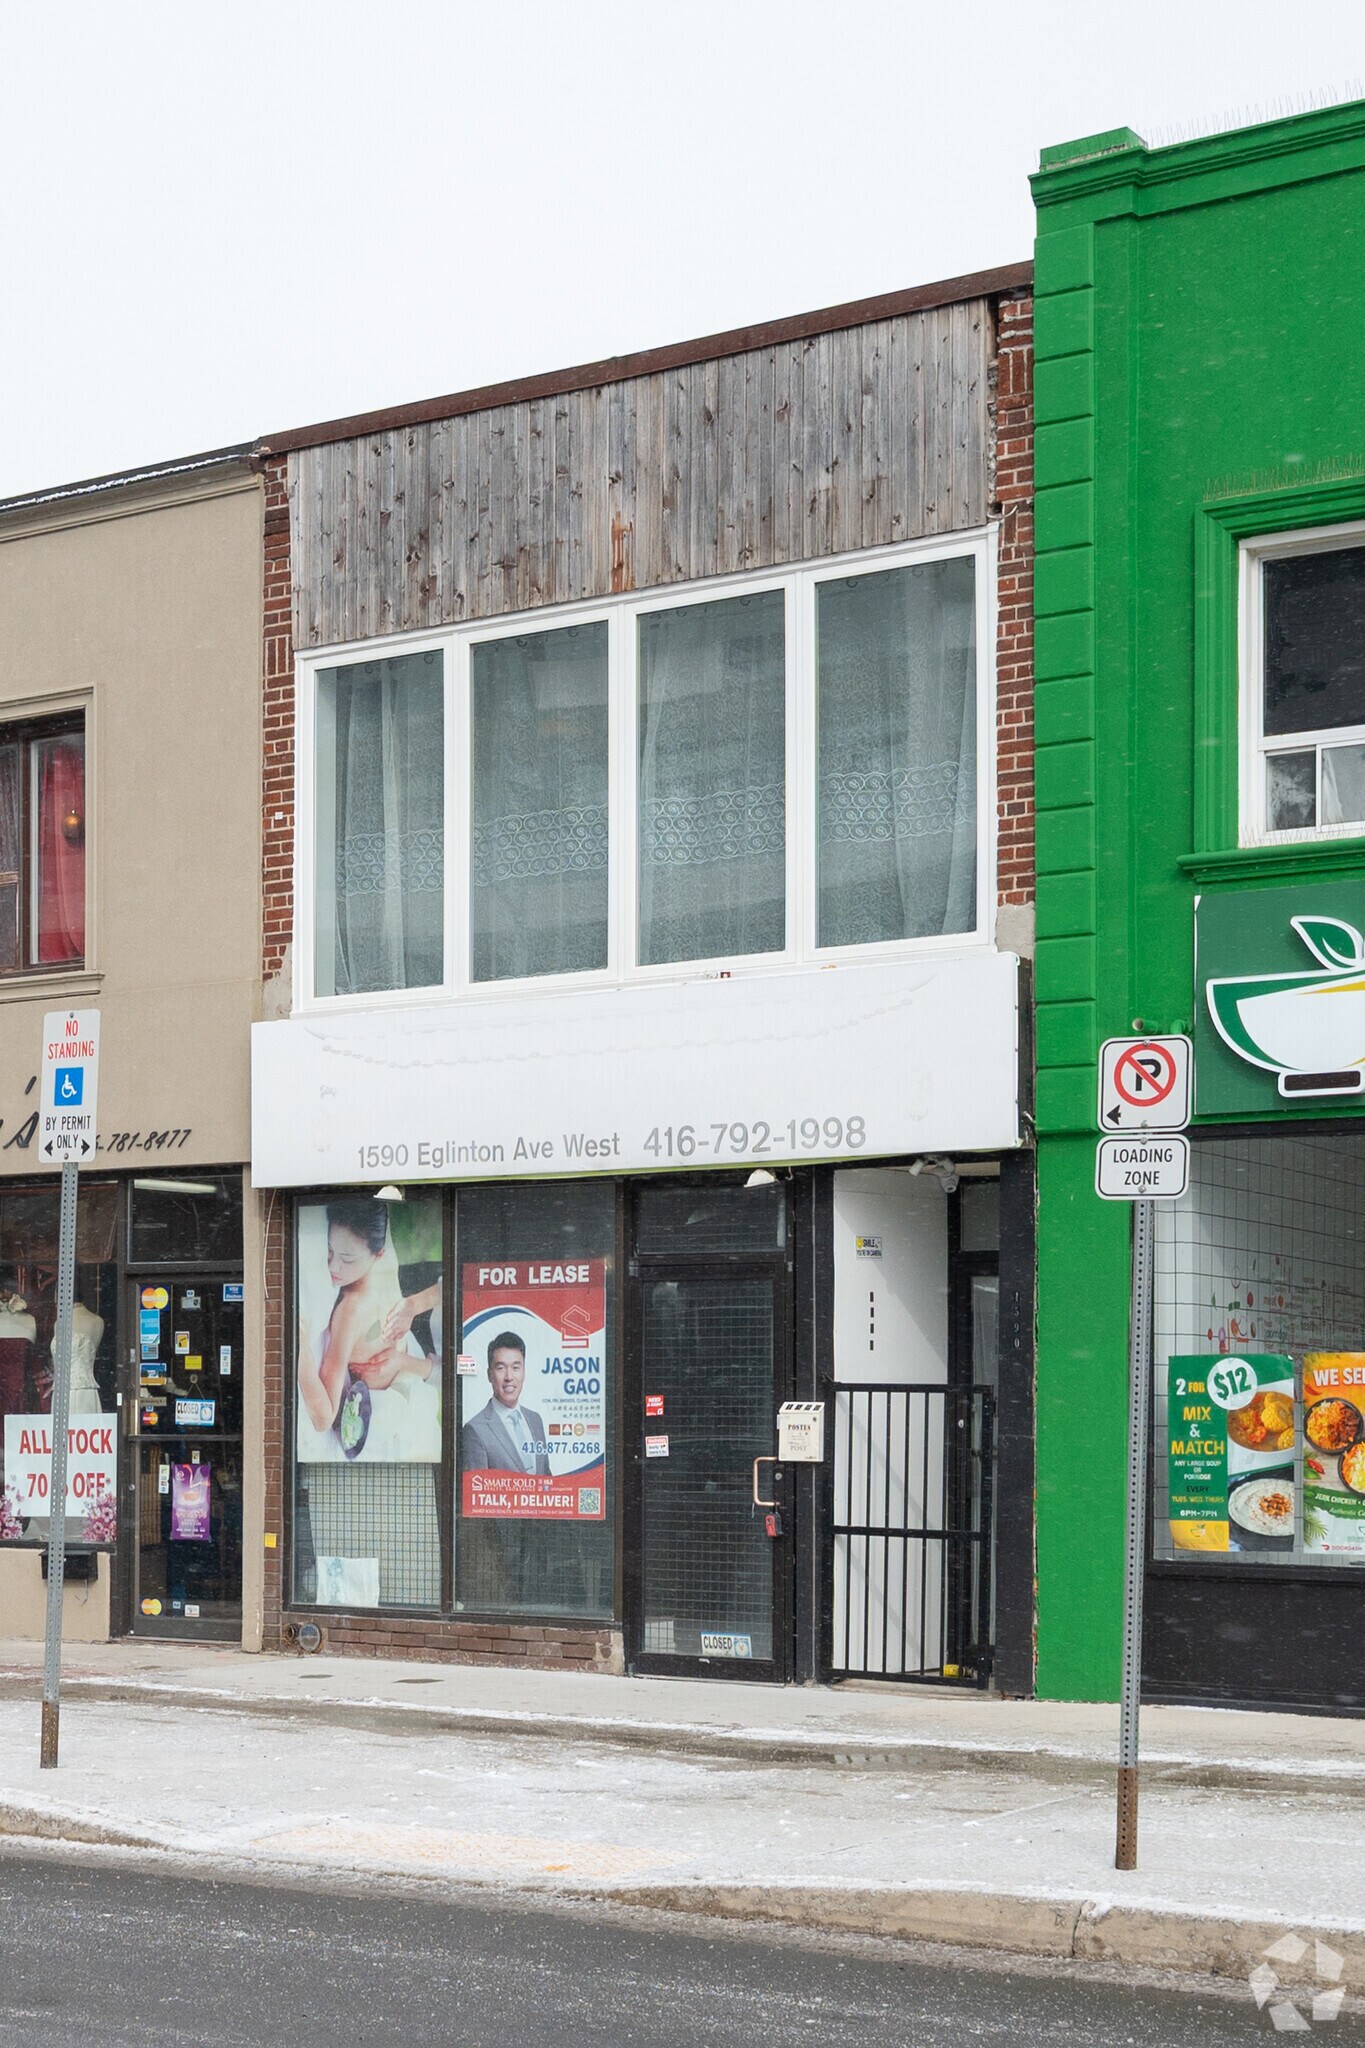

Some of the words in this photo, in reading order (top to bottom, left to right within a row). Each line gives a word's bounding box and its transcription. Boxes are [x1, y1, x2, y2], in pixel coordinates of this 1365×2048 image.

[65, 1020, 79, 1037] NO
[48, 1040, 95, 1060] STANDING
[46, 1116, 57, 1132] BY
[61, 1114, 91, 1131] PERMIT
[56, 1134, 79, 1149] ONLY
[643, 1115, 866, 1157] 416-792-1998
[358, 1143, 409, 1169] 1590
[417, 1140, 504, 1169] Eglinton
[512, 1136, 554, 1161] Ave
[562, 1132, 621, 1158] West
[1113, 1148, 1173, 1164] LOADING
[1124, 1170, 1160, 1186] ZONE
[479, 1267, 517, 1286] FOR
[528, 1264, 590, 1284] LEASE
[541, 1357, 600, 1374] JASON
[1175, 1378, 1187, 1396] 2
[1188, 1382, 1205, 1393] FOR
[1213, 1366, 1253, 1401] $12
[1313, 1368, 1340, 1387] WE
[563, 1378, 600, 1395] GAO
[176, 1403, 199, 1415] CLOSED
[1183, 1406, 1211, 1421] MIX
[1190, 1423, 1201, 1438] &
[19, 1429, 52, 1454] ALL
[66, 1428, 113, 1454] TOCK
[522, 1441, 601, 1454] 416.877.6268
[1171, 1440, 1225, 1455] MATCH
[27, 1472, 69, 1498] 70
[72, 1471, 106, 1498] OFF
[483, 1478, 511, 1488] SMART
[513, 1478, 536, 1488] SOLD
[1186, 1485, 1209, 1493] EVERY
[472, 1493, 476, 1506] I
[478, 1494, 512, 1509] TALK,
[513, 1494, 518, 1506] I
[520, 1495, 574, 1508] DELIVER!
[1315, 1493, 1331, 1502] JERK
[1330, 1495, 1357, 1506] CHICKEN
[1180, 1509, 1218, 1517] 6PM-7PM
[703, 1635, 733, 1650] CLOSED
